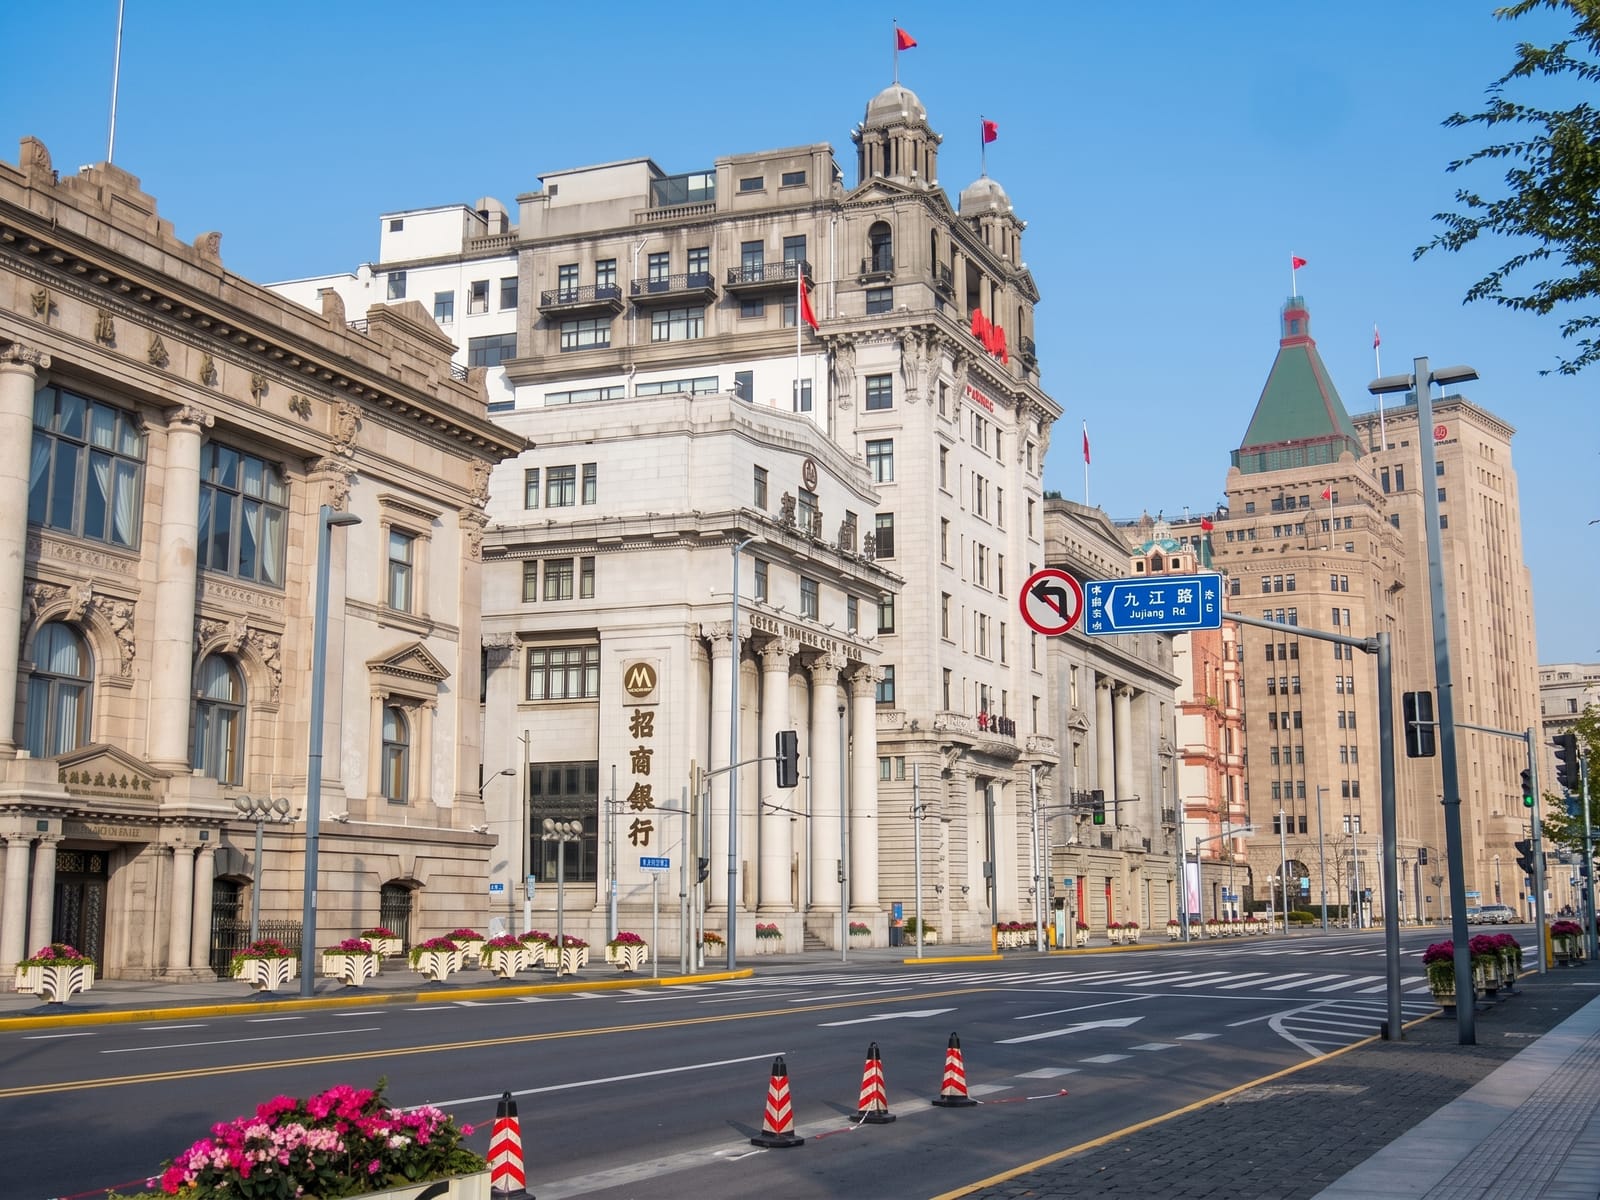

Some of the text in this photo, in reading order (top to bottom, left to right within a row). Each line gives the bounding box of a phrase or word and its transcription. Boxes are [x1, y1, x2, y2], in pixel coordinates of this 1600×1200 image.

[1124, 588, 1193, 607] 九江路
[627, 709, 655, 847] 招商銀行
